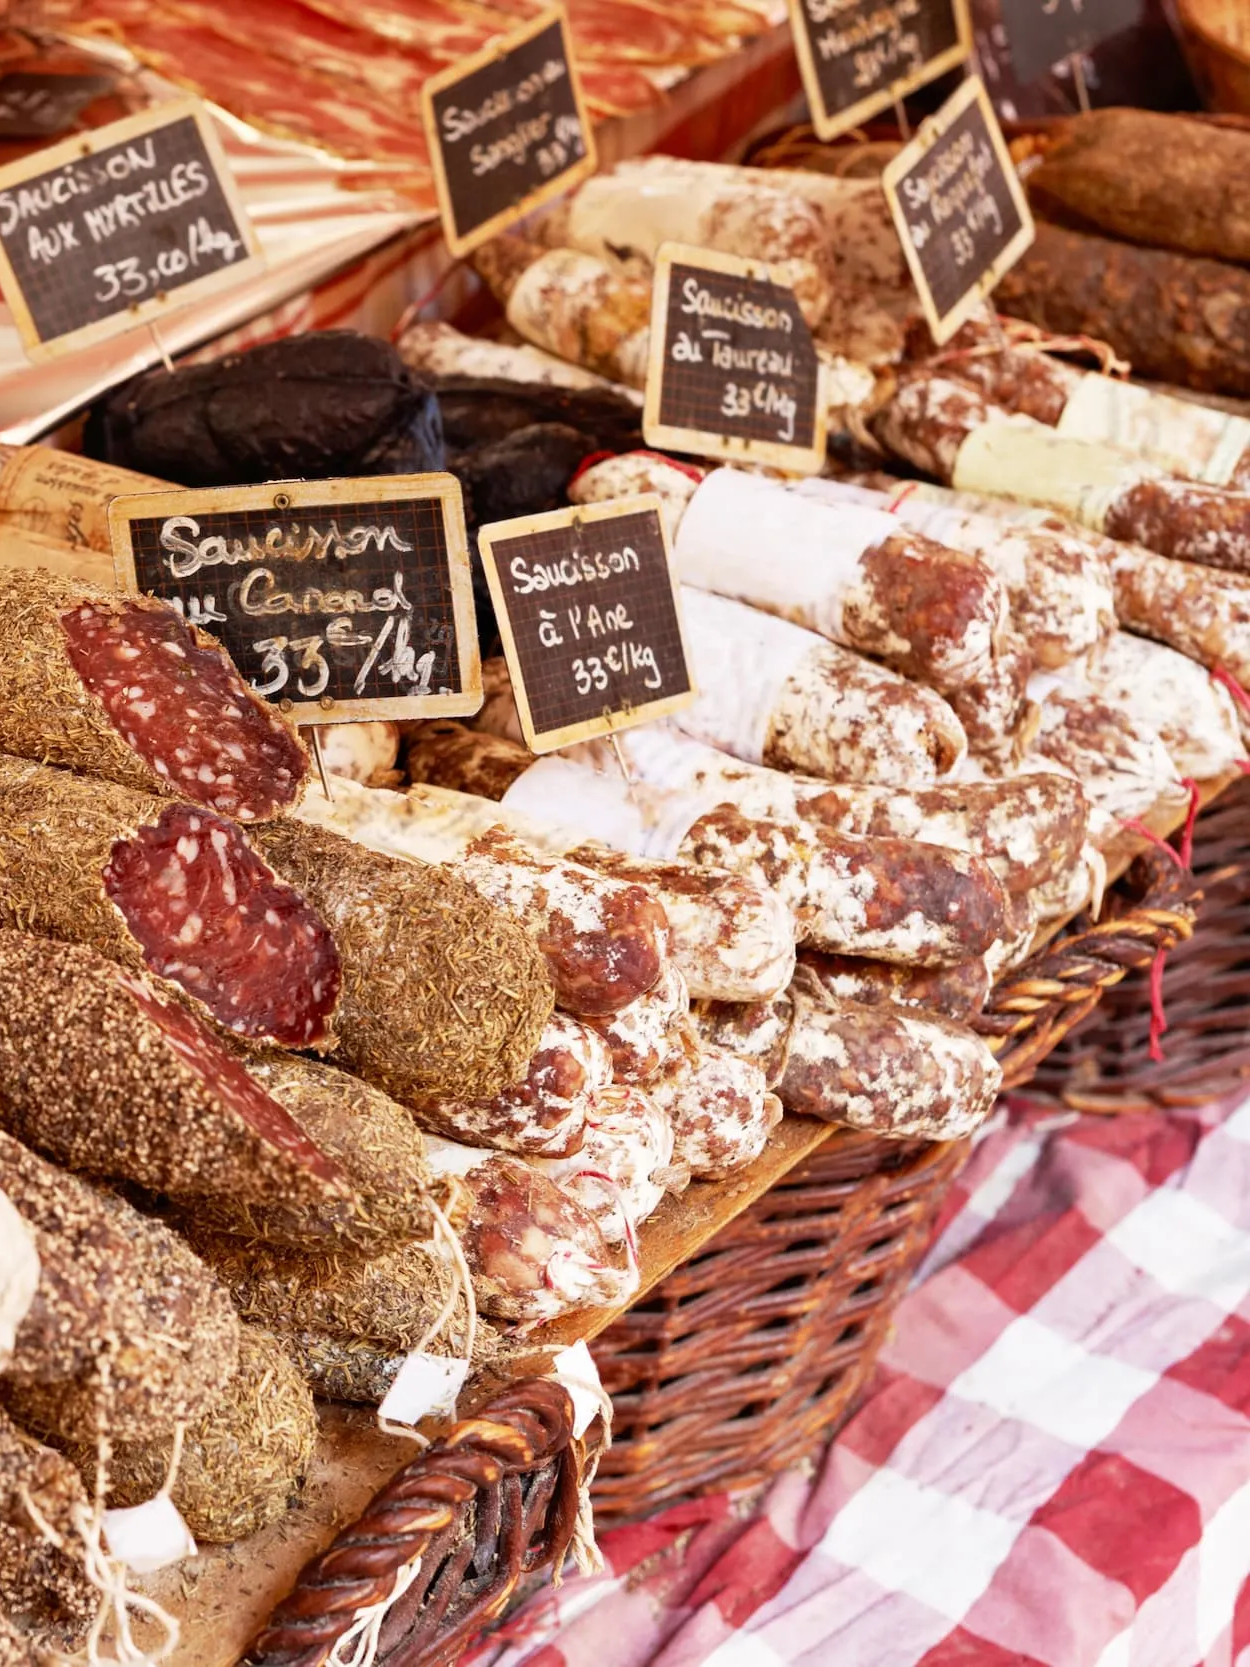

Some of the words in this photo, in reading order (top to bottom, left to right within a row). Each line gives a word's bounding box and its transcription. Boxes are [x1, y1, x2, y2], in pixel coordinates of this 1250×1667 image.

[27, 221, 80, 264] AUX
[681, 278, 792, 333] Saucisson
[702, 330, 794, 376] Taureau
[159, 517, 413, 578] Saucisson
[510, 547, 640, 593] Saucisson
[539, 609, 563, 647] à
[568, 604, 634, 640] l'Ane
